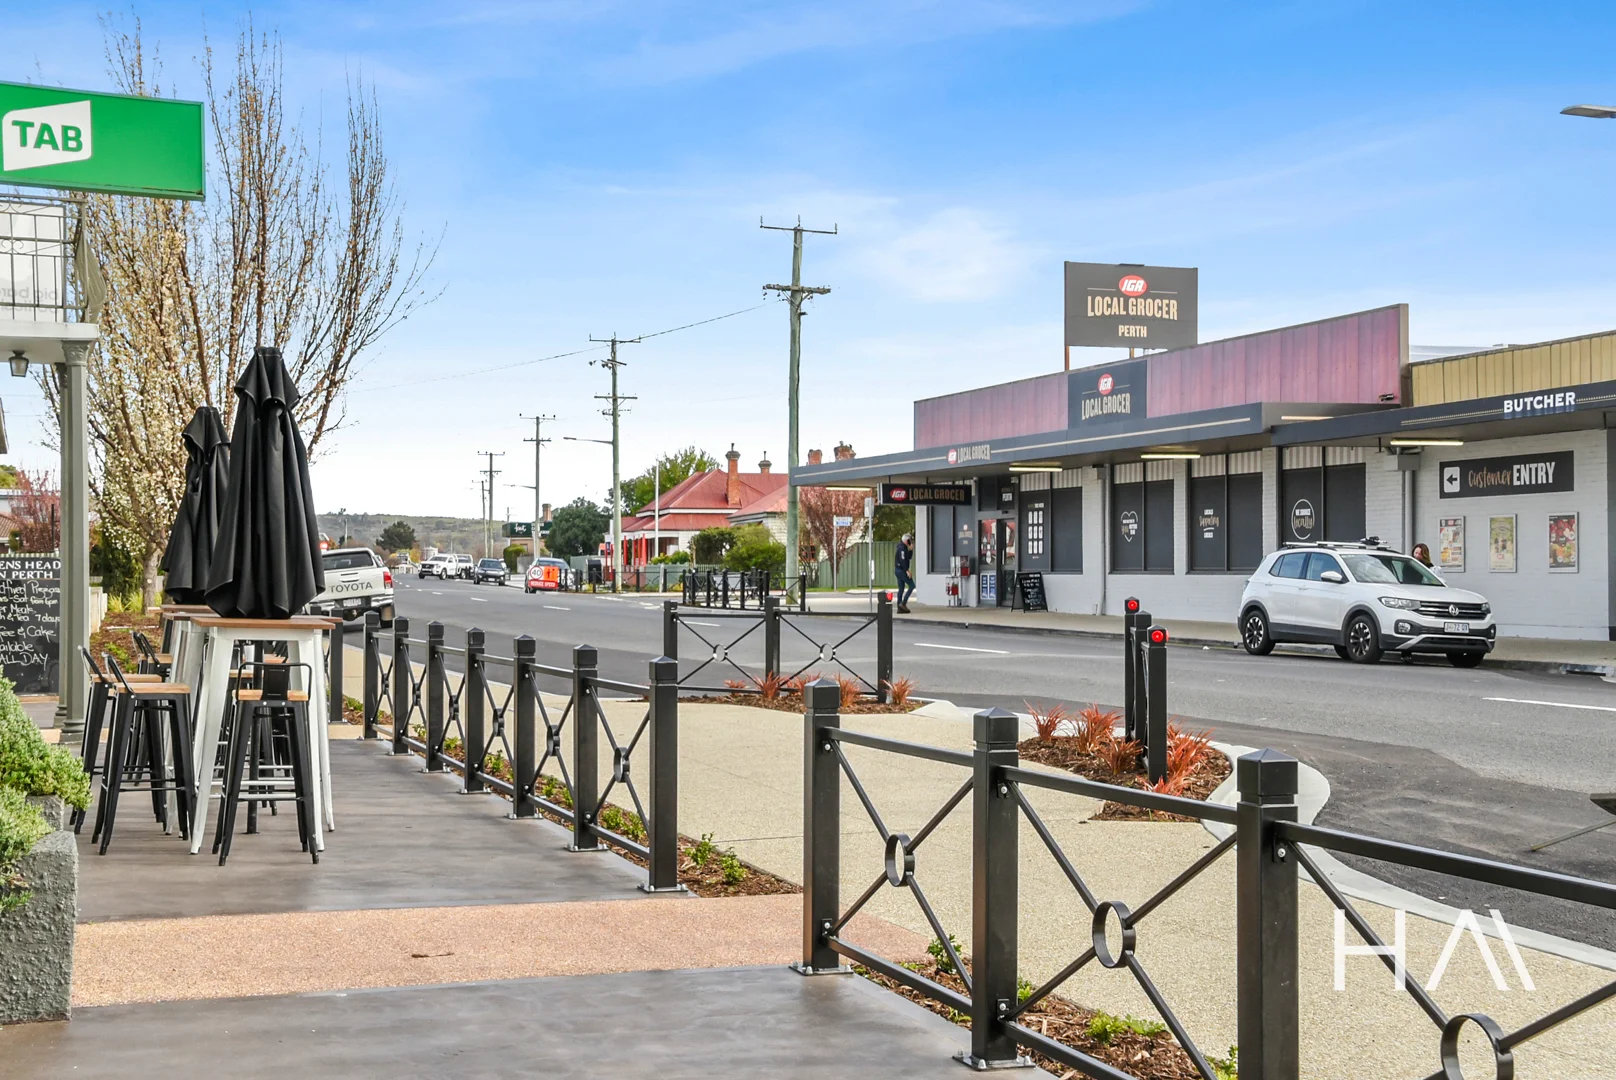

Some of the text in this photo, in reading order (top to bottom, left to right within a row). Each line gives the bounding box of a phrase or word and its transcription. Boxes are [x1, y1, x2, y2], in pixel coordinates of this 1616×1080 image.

[11, 120, 83, 152] TAB
[1122, 279, 1145, 292] IGA
[1087, 296, 1178, 320] LOCAL GROCER
[1118, 324, 1147, 338] PERTH
[1099, 377, 1112, 391] IGA
[1081, 393, 1131, 420] LOCAL GROCER
[1503, 392, 1576, 413] BUTCHER
[957, 446, 971, 463] LOCAL
[971, 444, 991, 460] GROCER
[1468, 461, 1556, 488] Customer ENTRY
[891, 488, 965, 501] IGA LOCAL GROCER
[25, 560, 62, 570] HEAD
[11, 570, 53, 579] PERTH
[328, 582, 373, 593] TOYOTA
[26, 625, 57, 643] Cake
[20, 651, 49, 671] DAY
